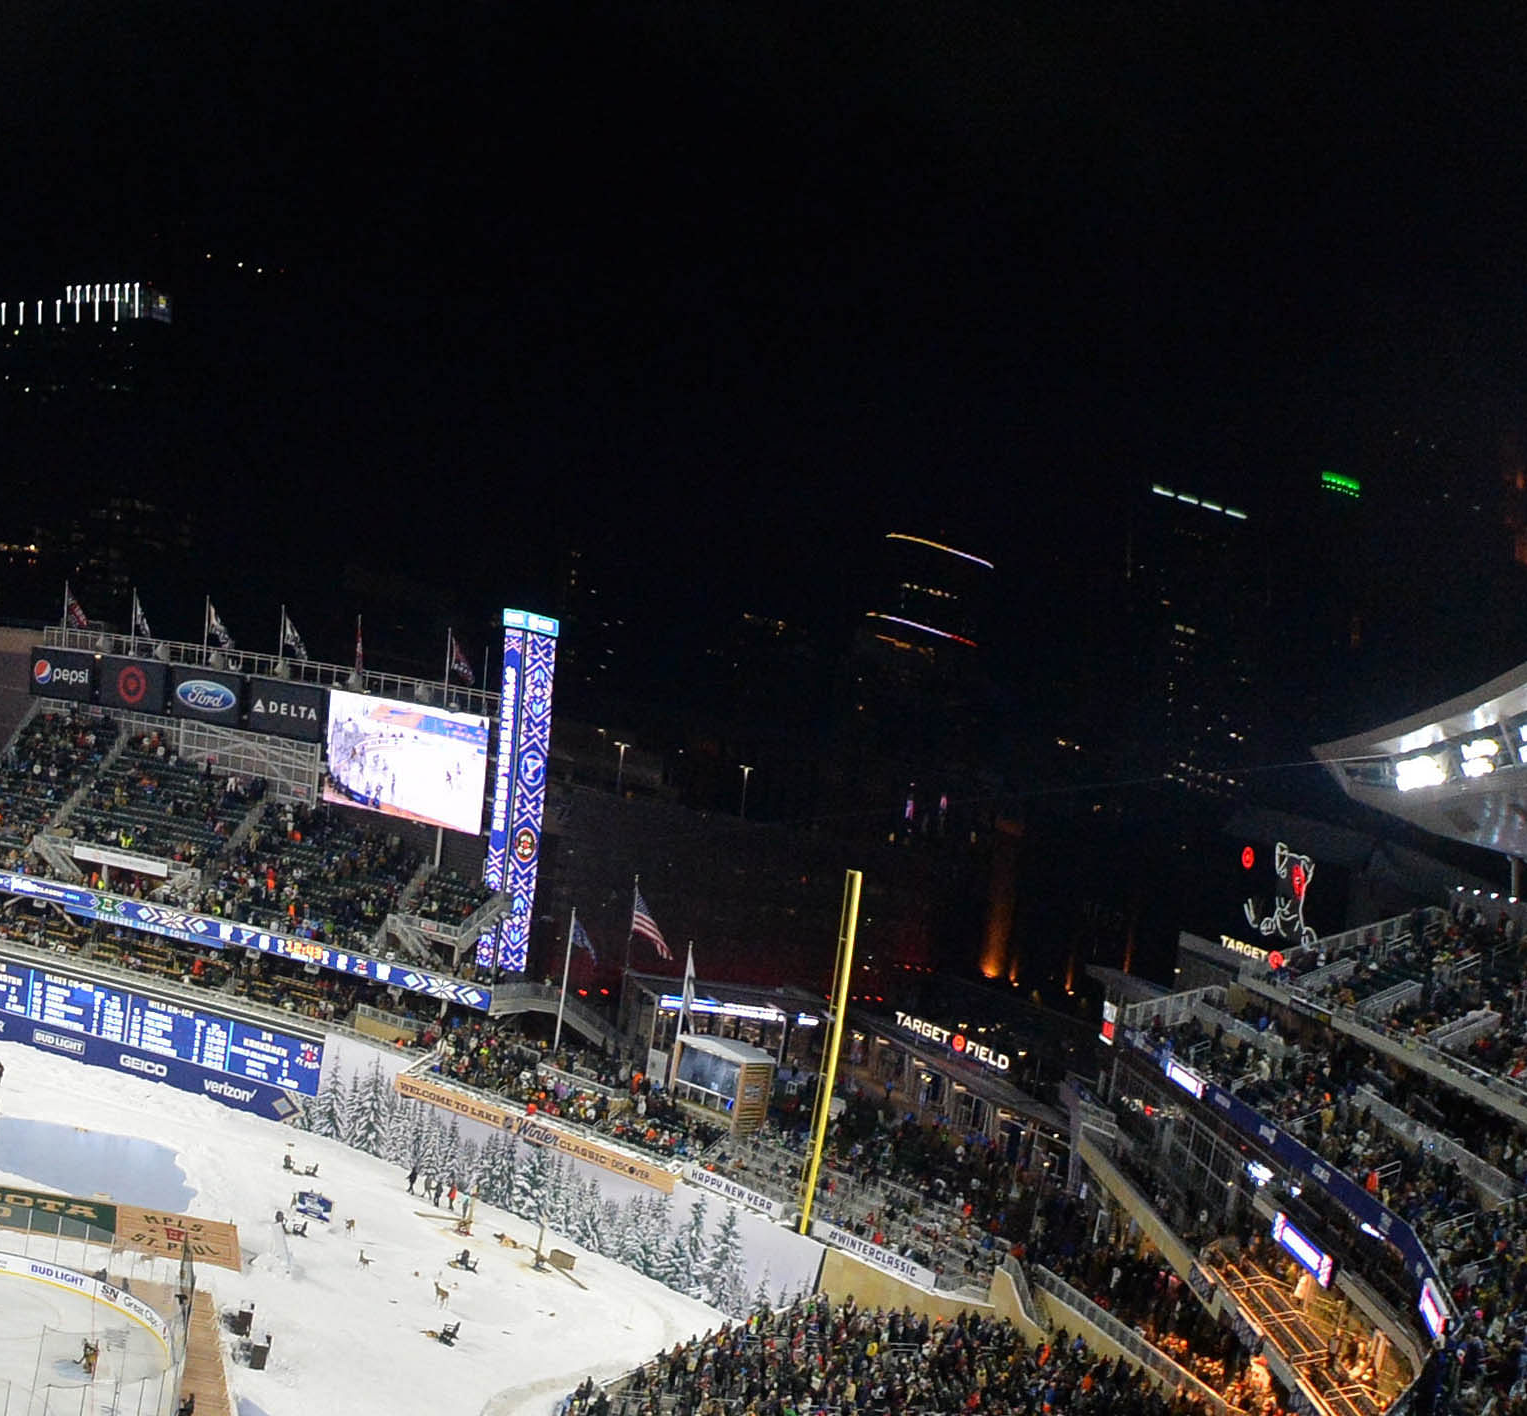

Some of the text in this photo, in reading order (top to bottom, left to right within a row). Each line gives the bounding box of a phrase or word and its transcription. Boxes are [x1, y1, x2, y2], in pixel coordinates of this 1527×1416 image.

[53, 667, 89, 685] pepsi
[187, 686, 224, 708] Ford
[269, 703, 317, 721] DELTA
[1220, 934, 1269, 961] TARGET
[35, 1031, 84, 1052] BUD LIGHT
[895, 1010, 1010, 1070] TARGET FIELD
[119, 1054, 168, 1077] GEICO
[204, 1079, 251, 1102] verizon
[400, 1081, 650, 1180] WELCOME TO LAKE Winter CLASSIC DISCOVER
[691, 1169, 774, 1212] HAPPY NEW YEAR
[143, 1214, 203, 1232] MPLS
[130, 1233, 159, 1249] ST.
[828, 1230, 918, 1278] #WINTERCLASSIC
[31, 1264, 85, 1287] BUD LIGHT
[101, 1285, 119, 1298] SN
